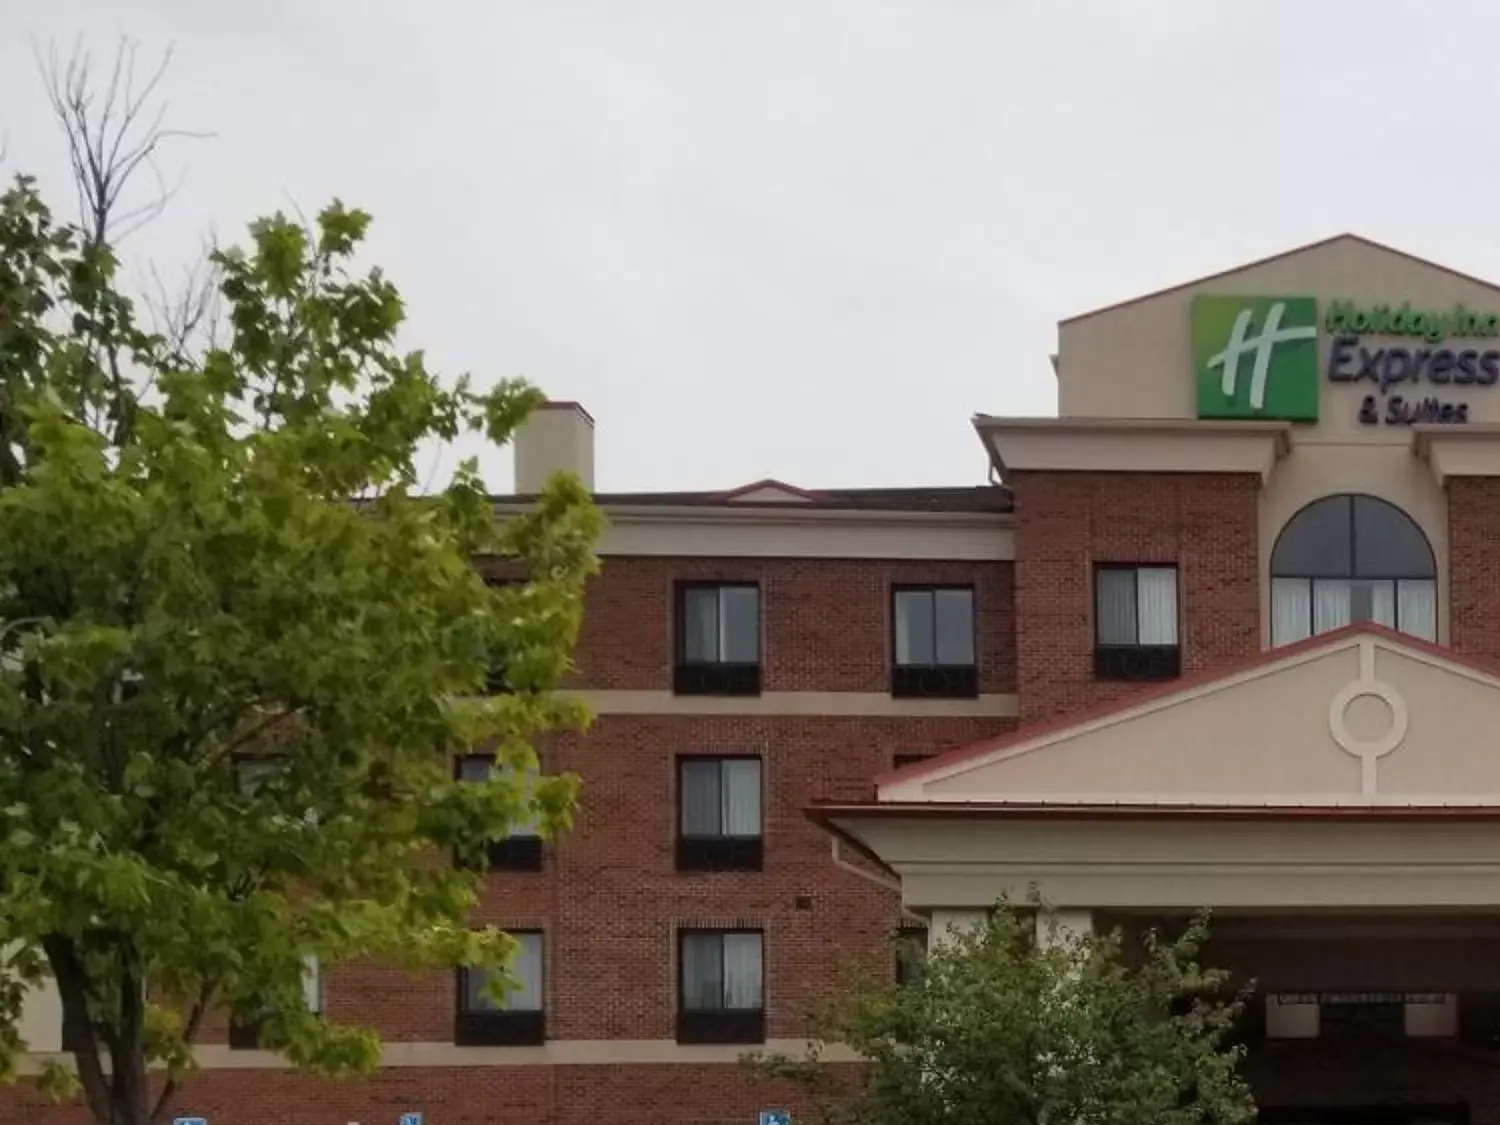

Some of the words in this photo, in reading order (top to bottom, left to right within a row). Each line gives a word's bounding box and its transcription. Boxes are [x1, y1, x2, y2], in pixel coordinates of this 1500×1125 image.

[1325, 301, 1446, 343] Holiday
[1359, 396, 1378, 424] &
[1385, 396, 1469, 425] Suites
